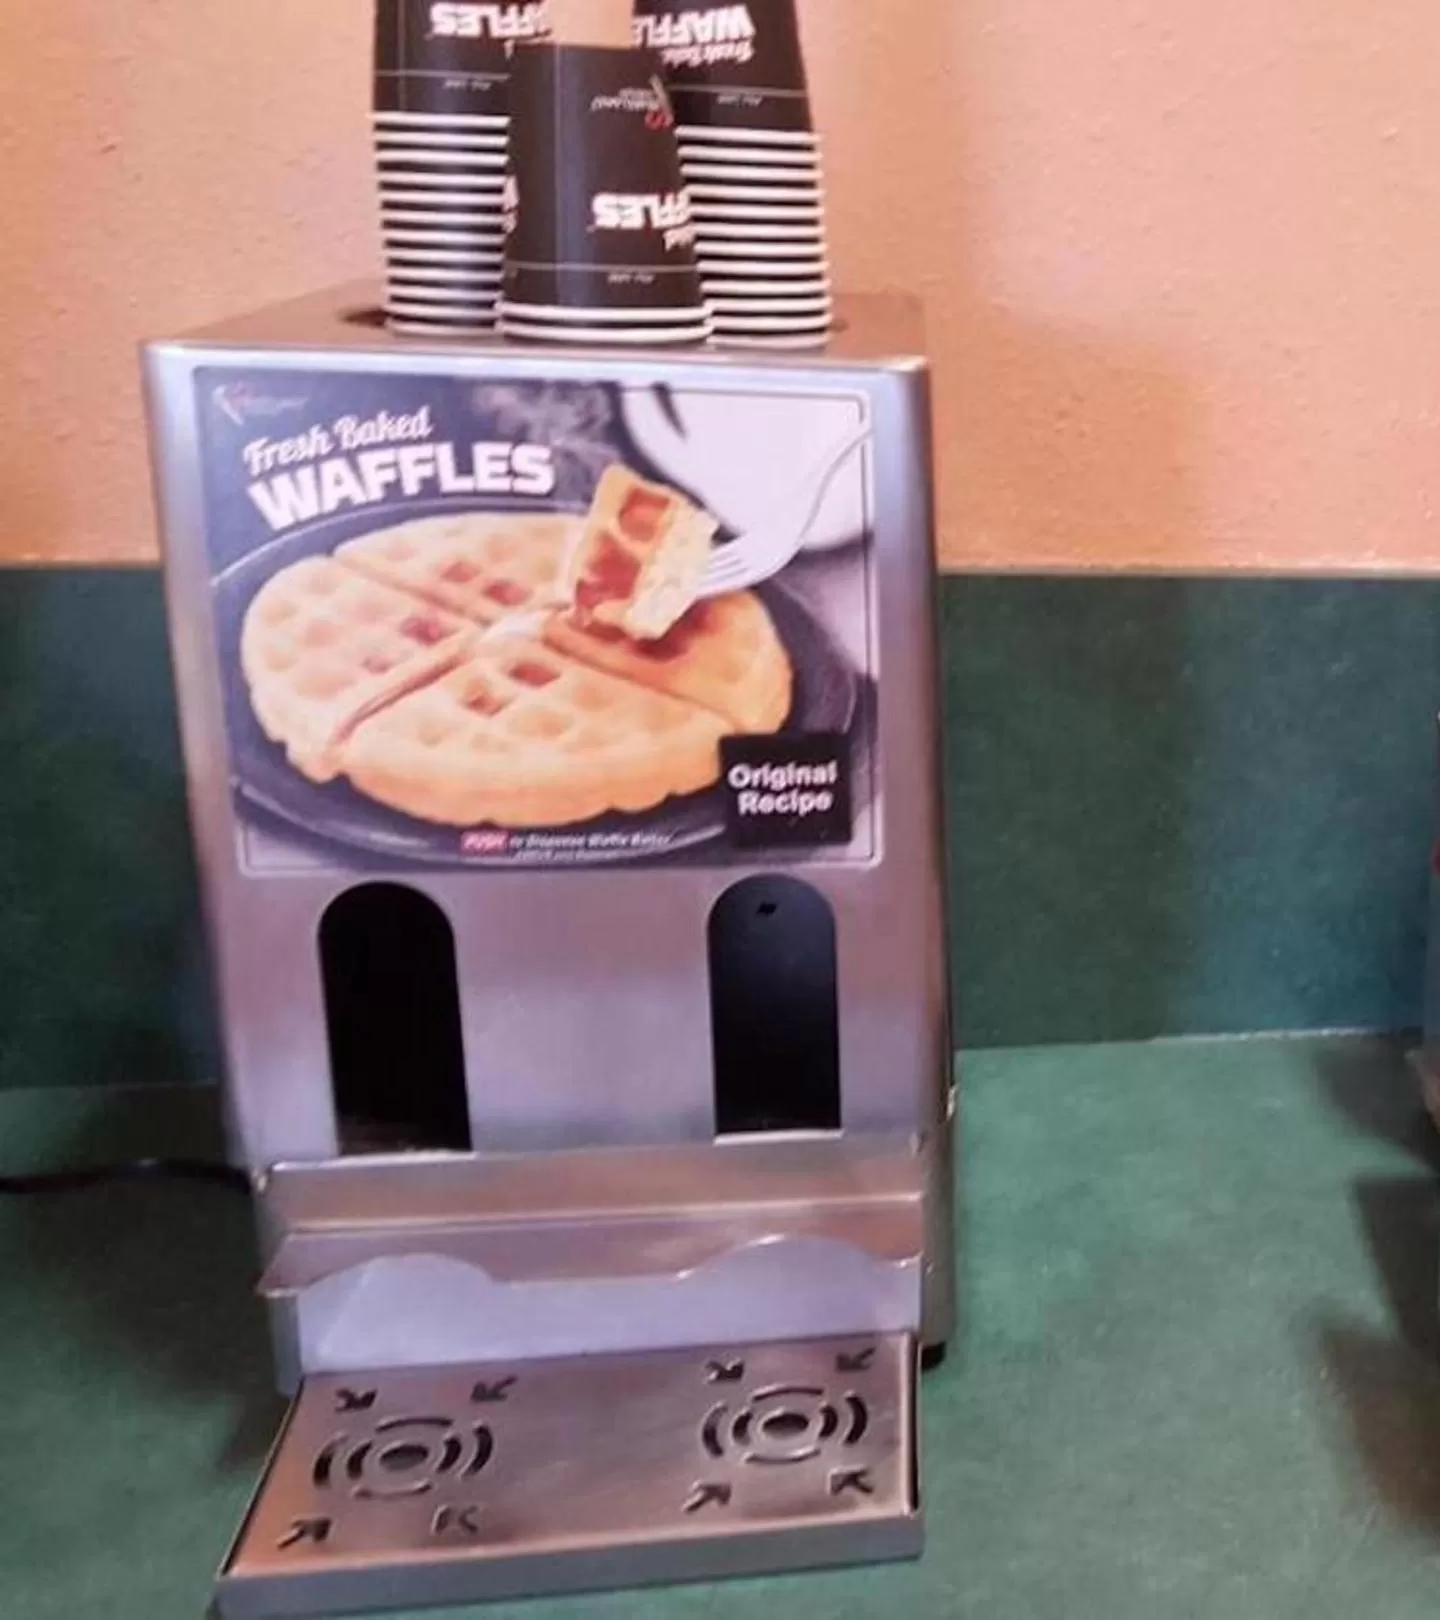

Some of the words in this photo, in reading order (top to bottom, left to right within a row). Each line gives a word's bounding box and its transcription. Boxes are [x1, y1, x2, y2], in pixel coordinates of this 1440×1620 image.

[631, 5, 755, 47] WAFFLE
[242, 426, 334, 476] Fresh
[332, 406, 434, 450] Baked
[247, 441, 555, 532] WAFFLES
[728, 761, 837, 791] Original
[738, 788, 833, 816] Recipe
